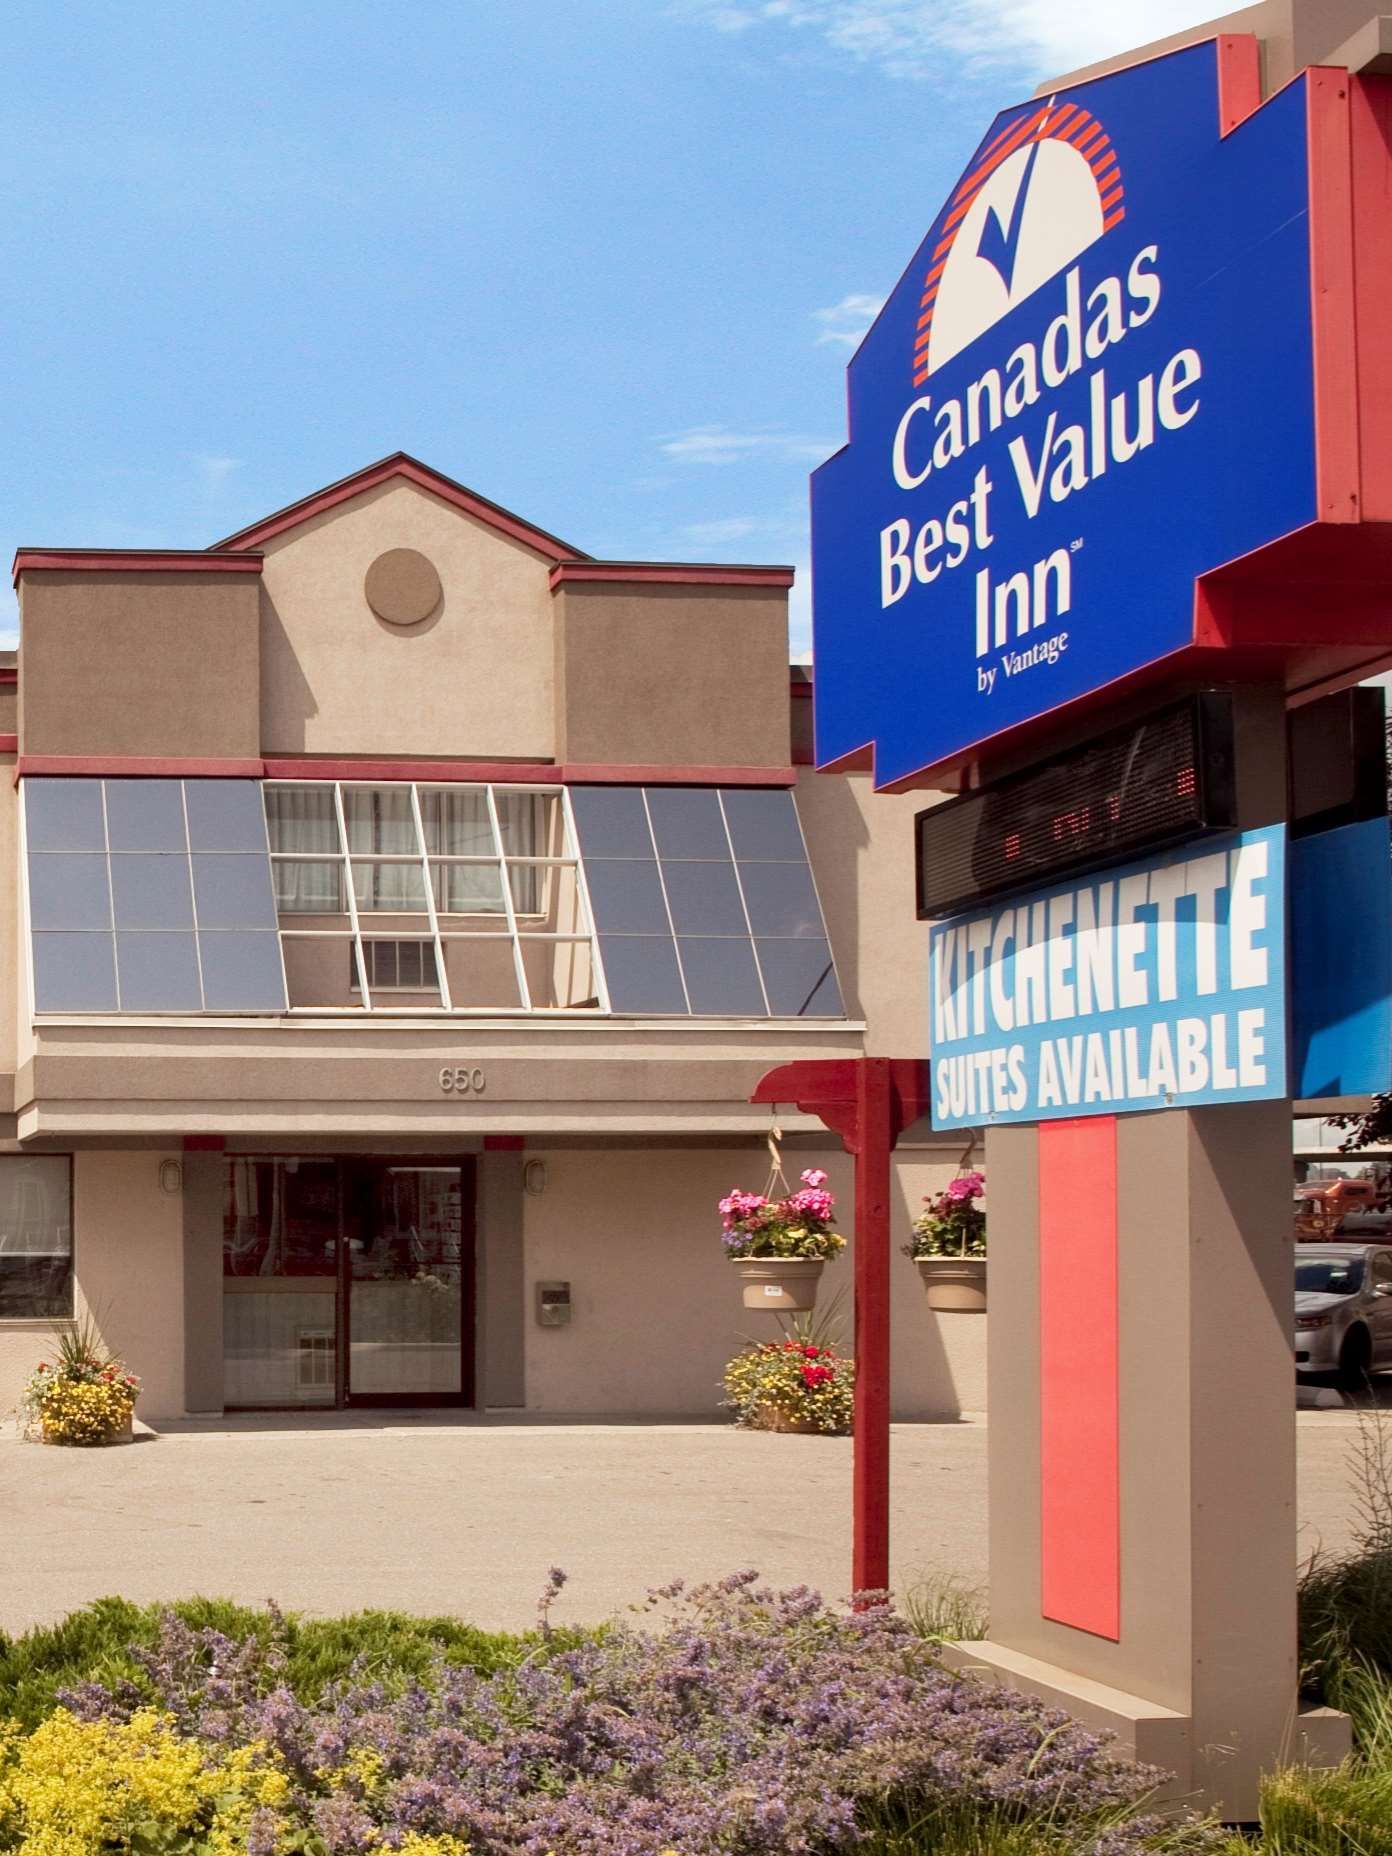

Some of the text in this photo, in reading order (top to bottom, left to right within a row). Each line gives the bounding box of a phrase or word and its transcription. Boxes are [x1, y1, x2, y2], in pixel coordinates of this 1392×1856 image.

[891, 244, 1162, 490] Canadas
[880, 348, 1203, 609] Best Value
[976, 548, 1071, 659] Inn
[976, 632, 1069, 695] by Vantage
[934, 840, 1269, 1044] KITCHENETTE
[439, 1067, 485, 1093] 650
[936, 1007, 1266, 1120] SUITES AVAILABLE
